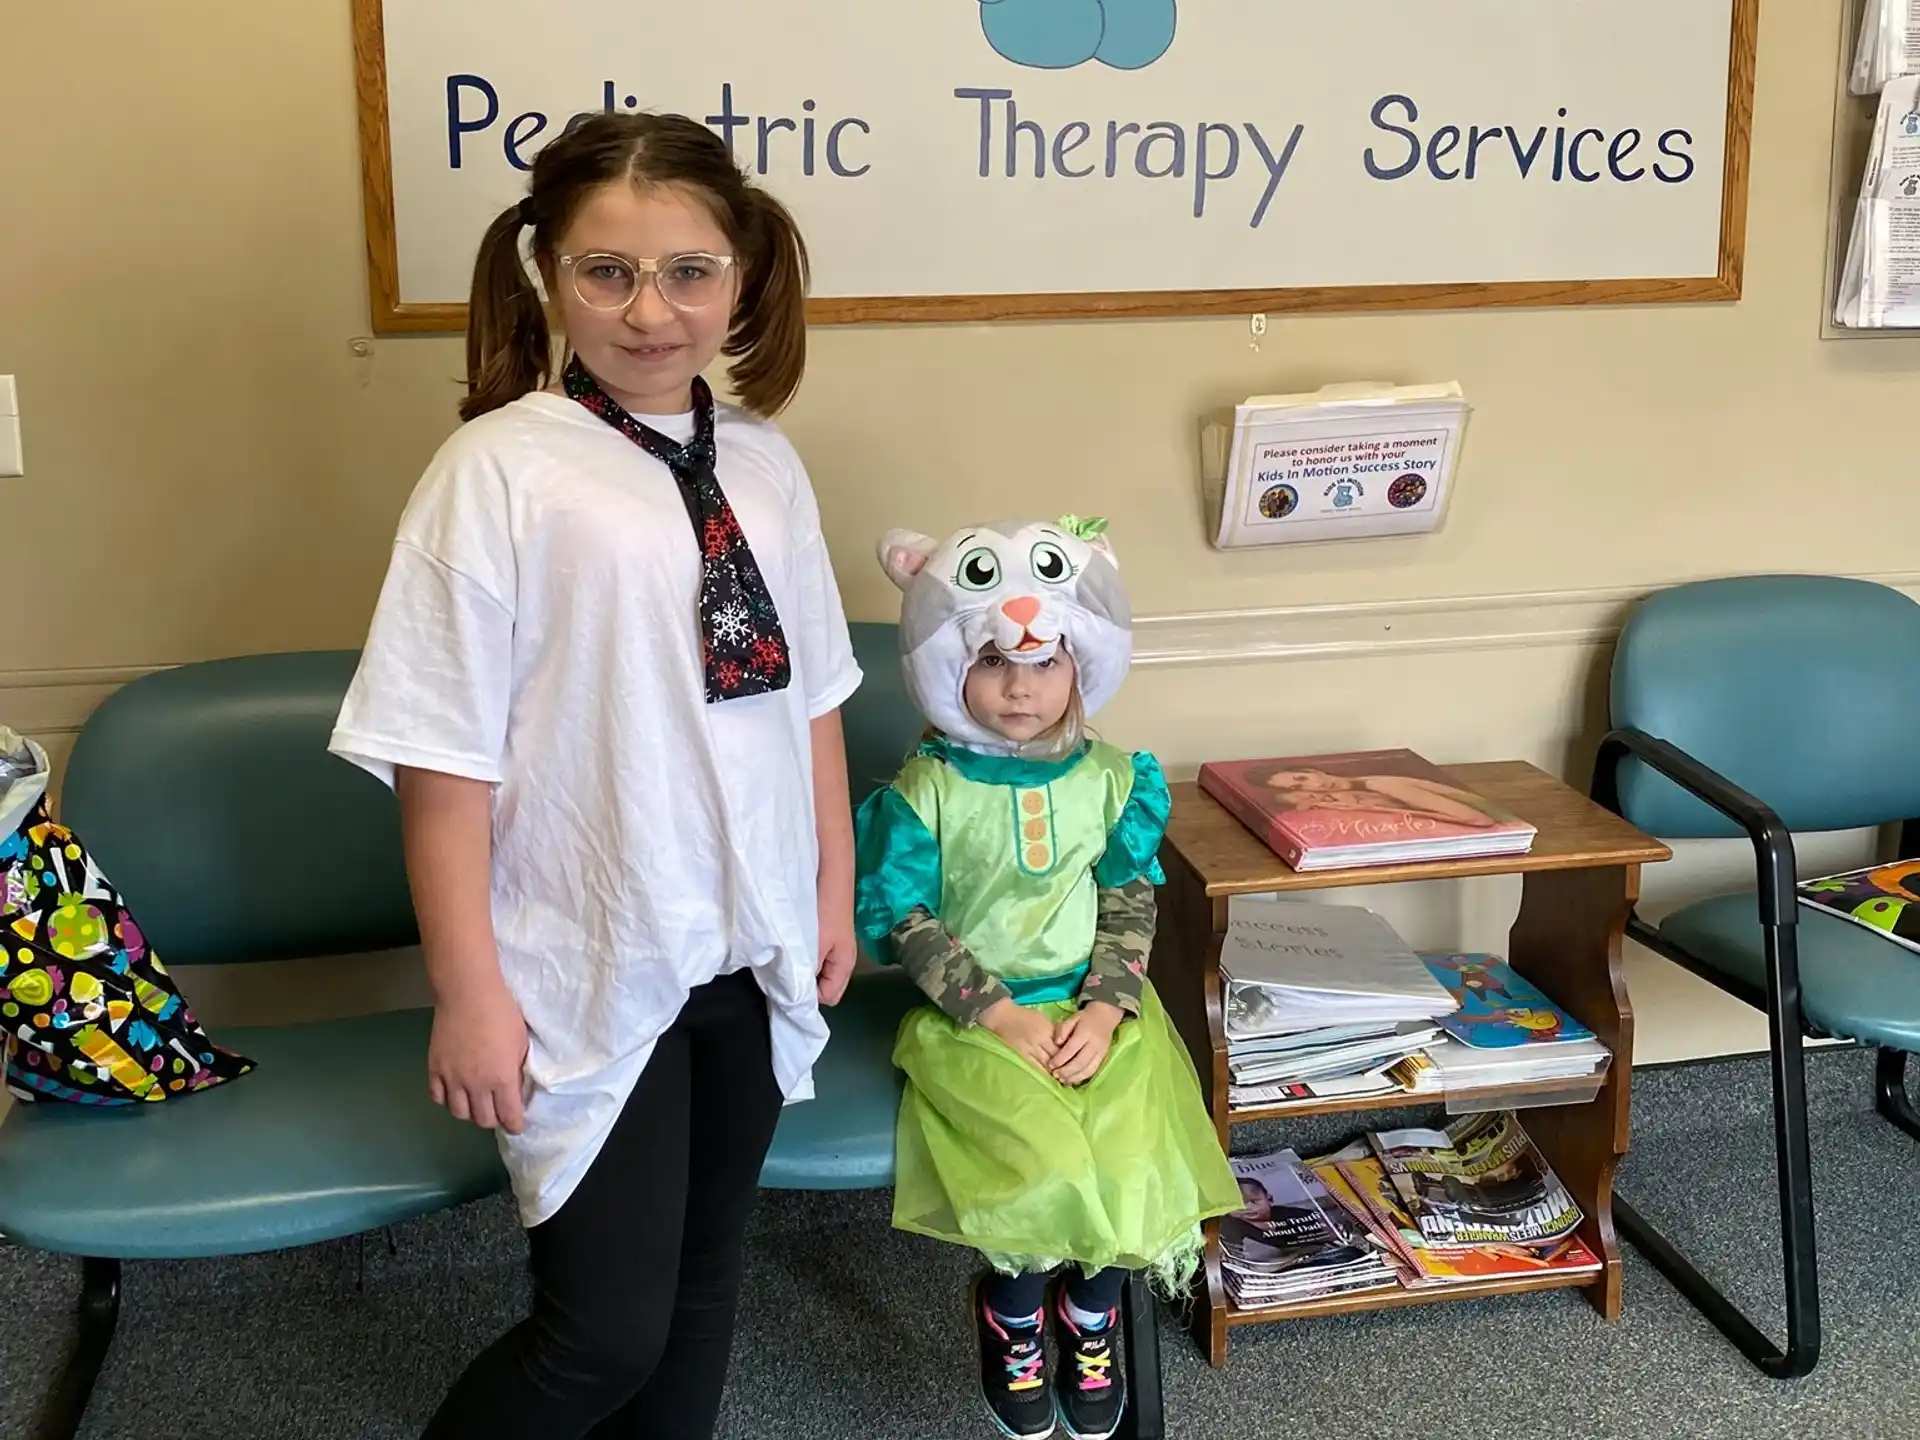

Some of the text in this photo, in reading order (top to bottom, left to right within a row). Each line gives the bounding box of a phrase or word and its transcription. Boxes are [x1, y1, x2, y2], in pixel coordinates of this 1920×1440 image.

[446, 74, 1694, 228] Petric Therapy Services
[1263, 437, 1438, 459] Please consider taking a moment
[1292, 451, 1406, 467] to honor us with your
[1257, 459, 1437, 482] Kids In Motion Success Story
[1230, 920, 1329, 938] uccess
[1390, 1162, 1408, 1174] VS
[1288, 1211, 1322, 1226] Truth
[1456, 1206, 1579, 1242] BRONCO MEETS WRANGLER
[1262, 1227, 1297, 1239] About
[1298, 1221, 1327, 1234] Dads
